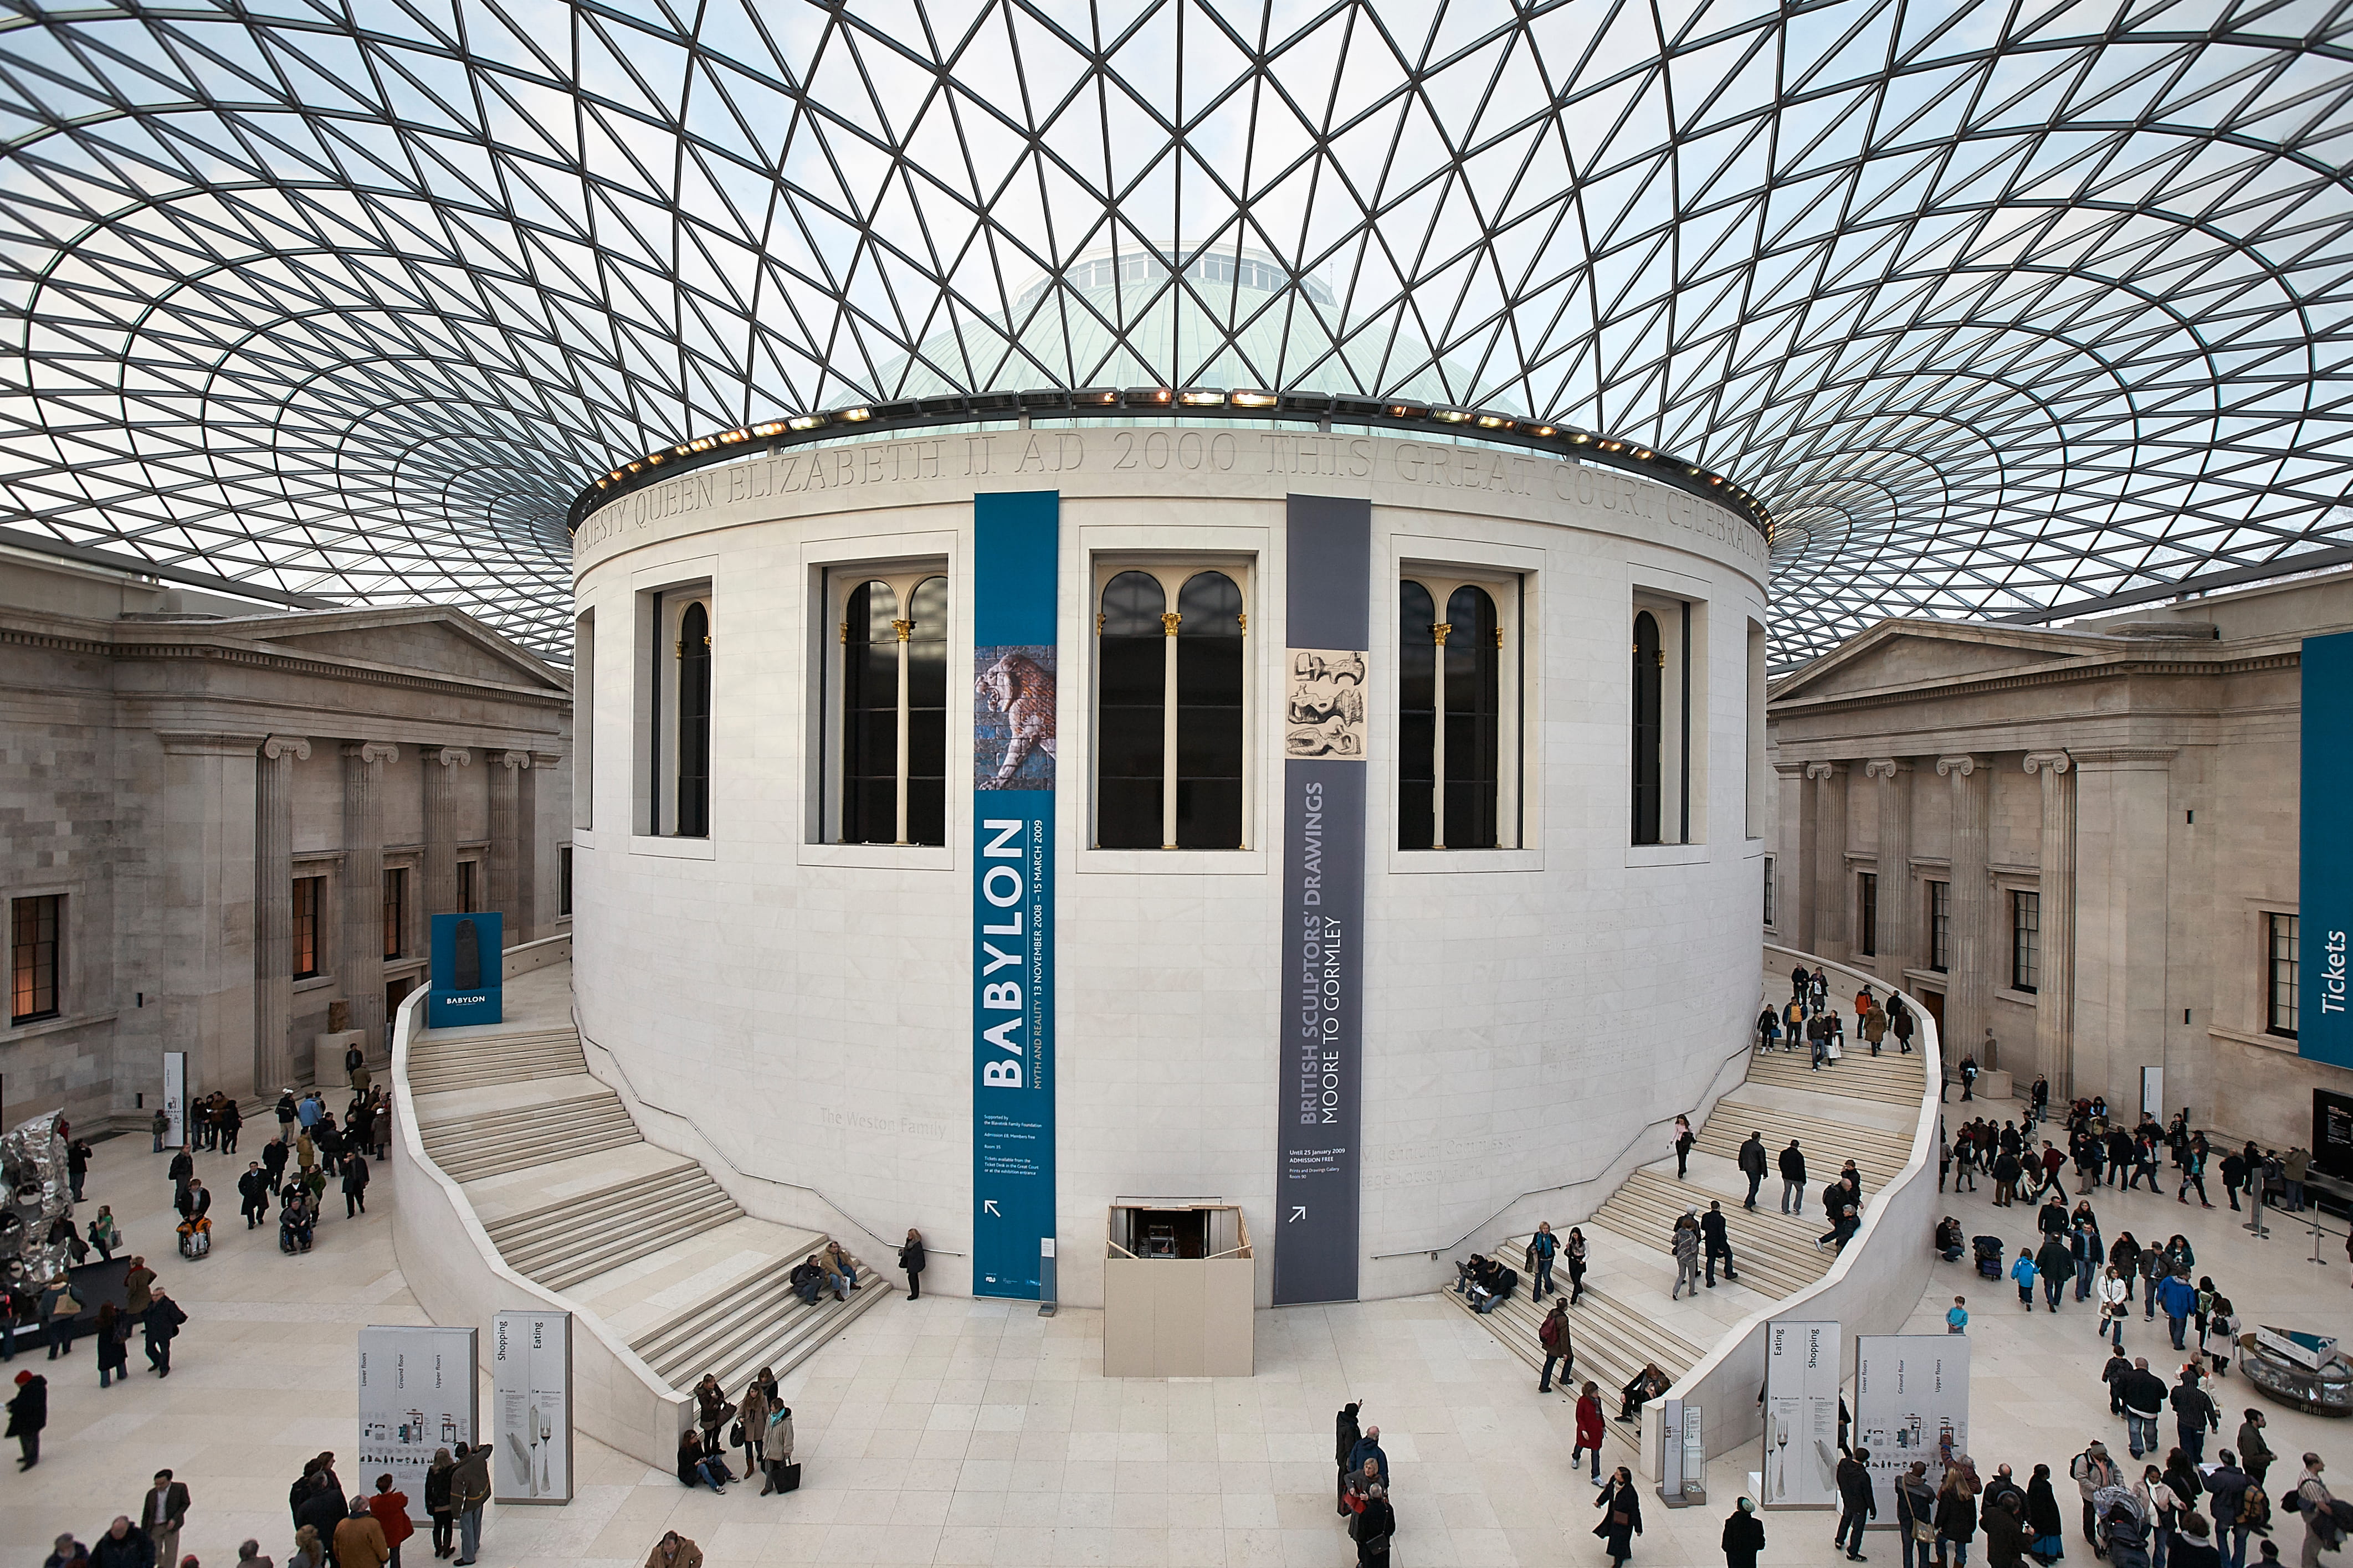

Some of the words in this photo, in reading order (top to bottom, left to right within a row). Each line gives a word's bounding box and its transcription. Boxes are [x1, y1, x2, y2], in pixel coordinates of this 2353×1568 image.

[577, 498, 628, 559] MAJESTY
[635, 472, 716, 529] QUEEN
[727, 440, 946, 503] ELIZABETH
[965, 436, 997, 475] II
[1014, 433, 1086, 472] AD
[1113, 431, 1237, 470] 2000
[1260, 435, 1371, 477] THIS
[1395, 443, 1535, 496] GREAT
[1553, 464, 1655, 519] COURT
[1667, 491, 1764, 567] CELEBRATING
[1034, 819, 1043, 843] 2009
[1304, 782, 1323, 907] DRAWINGS
[1034, 846, 1043, 881] MARCH
[1034, 883, 1043, 894] 15
[1034, 904, 1043, 928] 2008
[983, 819, 1023, 1088] BABYLON
[1034, 930, 1042, 983] NOVEMBER
[1324, 916, 1341, 1013] GORMLEY
[2321, 930, 2346, 1014] Tickets
[447, 996, 485, 1004] BABYLON
[1034, 985, 1042, 996] 13
[1033, 999, 1042, 1036] REALITY
[1323, 1017, 1339, 1045] TO
[1033, 1038, 1042, 1060] AND
[1033, 1062, 1042, 1089] MYTH
[1300, 1045, 1318, 1124] BRITISH
[1322, 1050, 1339, 1124] MOORE
[821, 1107, 842, 1124] The
[847, 1112, 894, 1131] Weston
[901, 1118, 946, 1139] Family
[498, 1321, 507, 1360] Shopping
[533, 1322, 544, 1349] Eating
[1774, 1329, 1785, 1355] Eating
[1809, 1329, 1819, 1368] Shopping
